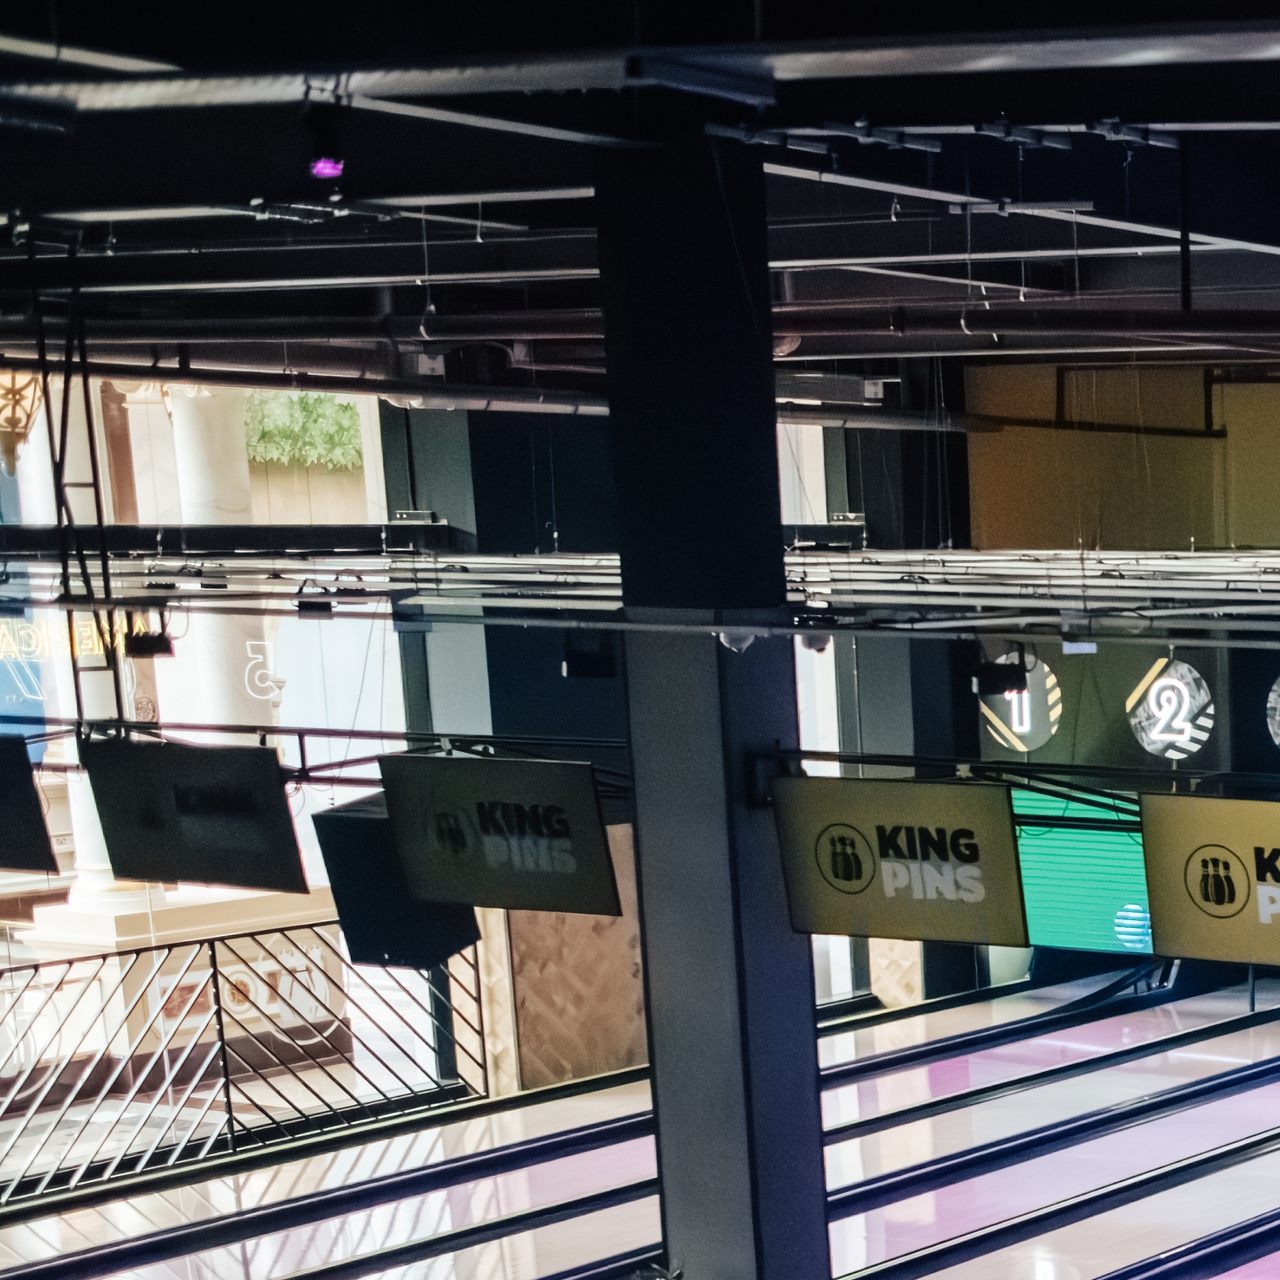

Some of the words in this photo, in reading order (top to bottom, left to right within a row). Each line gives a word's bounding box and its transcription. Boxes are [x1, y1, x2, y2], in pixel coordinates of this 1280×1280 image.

[1004, 689, 1030, 733] 1
[1150, 678, 1192, 741] 2
[875, 825, 979, 863] KING
[880, 858, 985, 903] PINS
